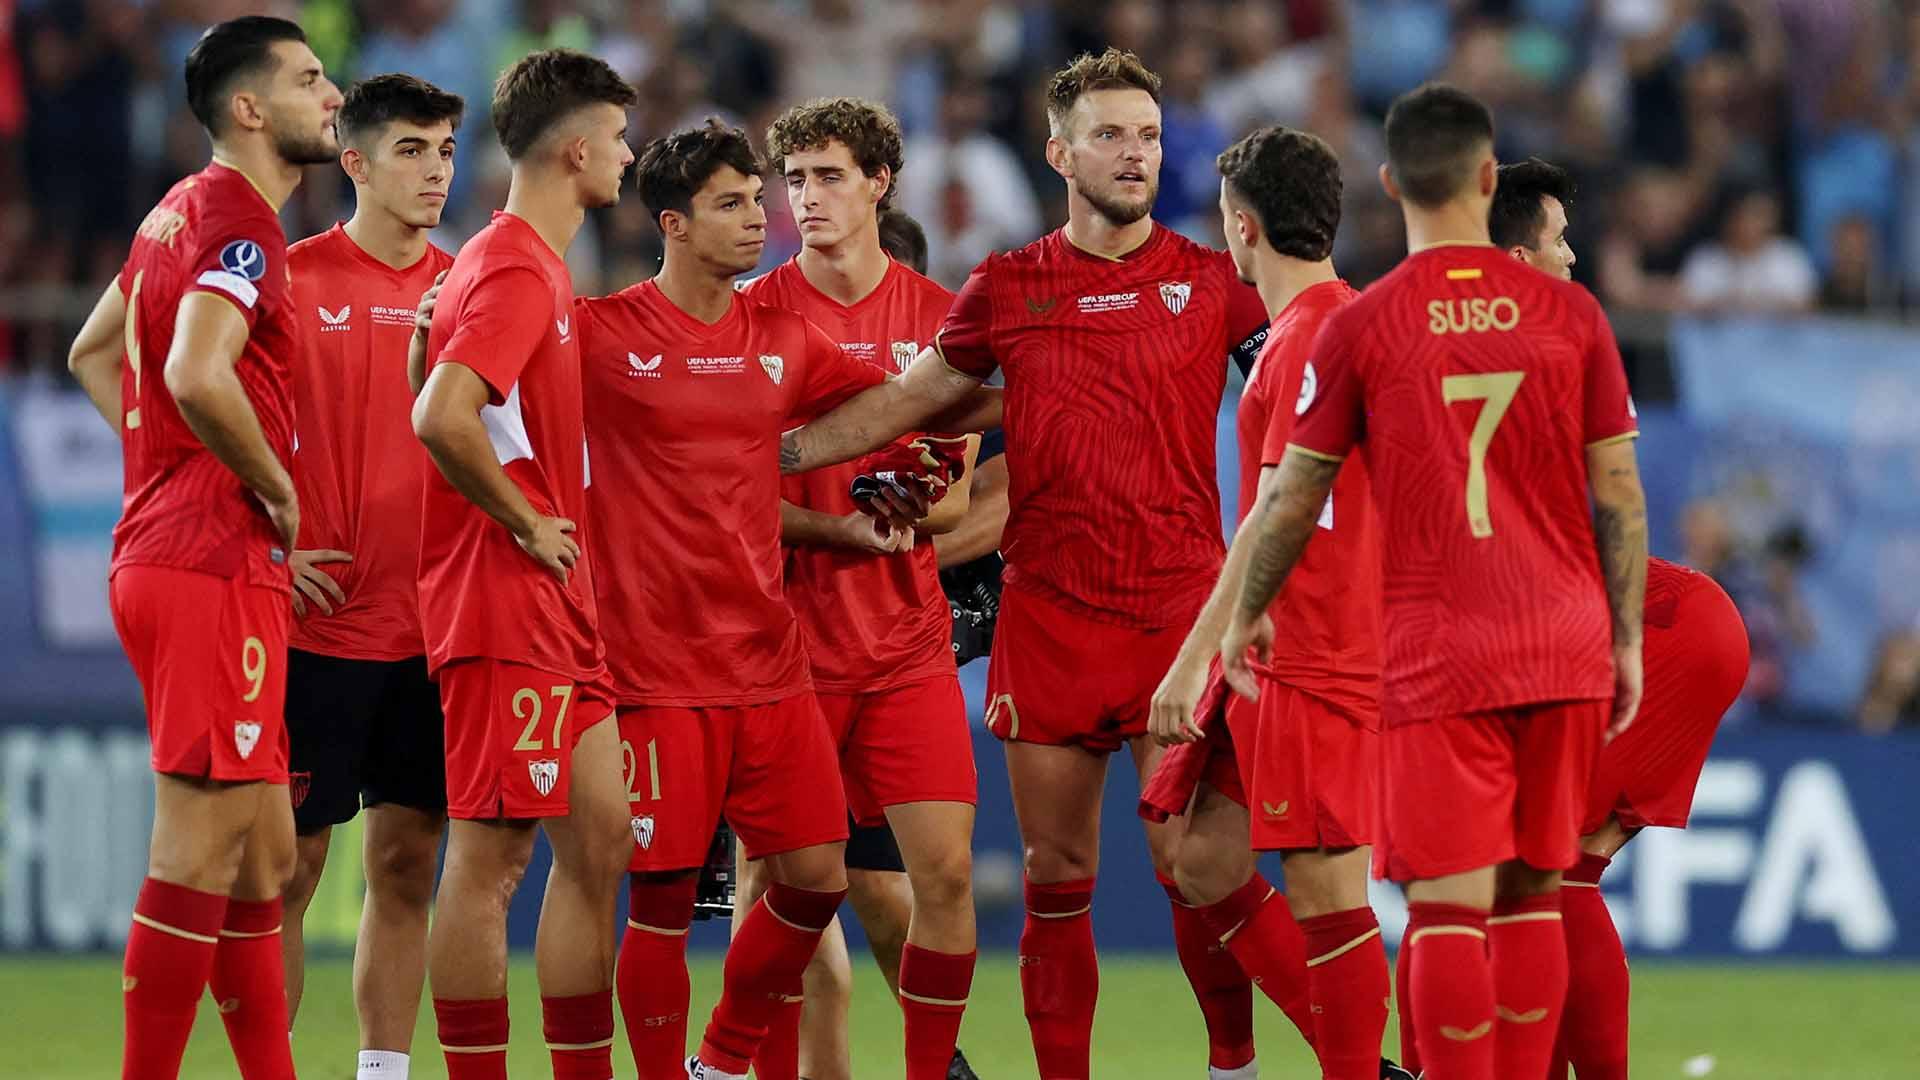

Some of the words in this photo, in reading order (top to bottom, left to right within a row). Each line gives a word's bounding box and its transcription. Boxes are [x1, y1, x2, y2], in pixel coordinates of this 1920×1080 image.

[370, 306, 388, 314] UEFA
[388, 308, 409, 317] SUPER
[1078, 295, 1097, 304] UEFA
[1098, 294, 1121, 303] SUPER
[1121, 293, 1137, 301] CUP
[1427, 296, 1521, 335] SUSO
[686, 357, 705, 365] UEFA
[706, 356, 729, 365] SUPER
[1239, 339, 1254, 352] NO
[1253, 331, 1267, 343] TO
[1441, 370, 1527, 539] 7
[242, 636, 267, 703] 9
[512, 685, 575, 751] 27
[621, 737, 662, 802] 21
